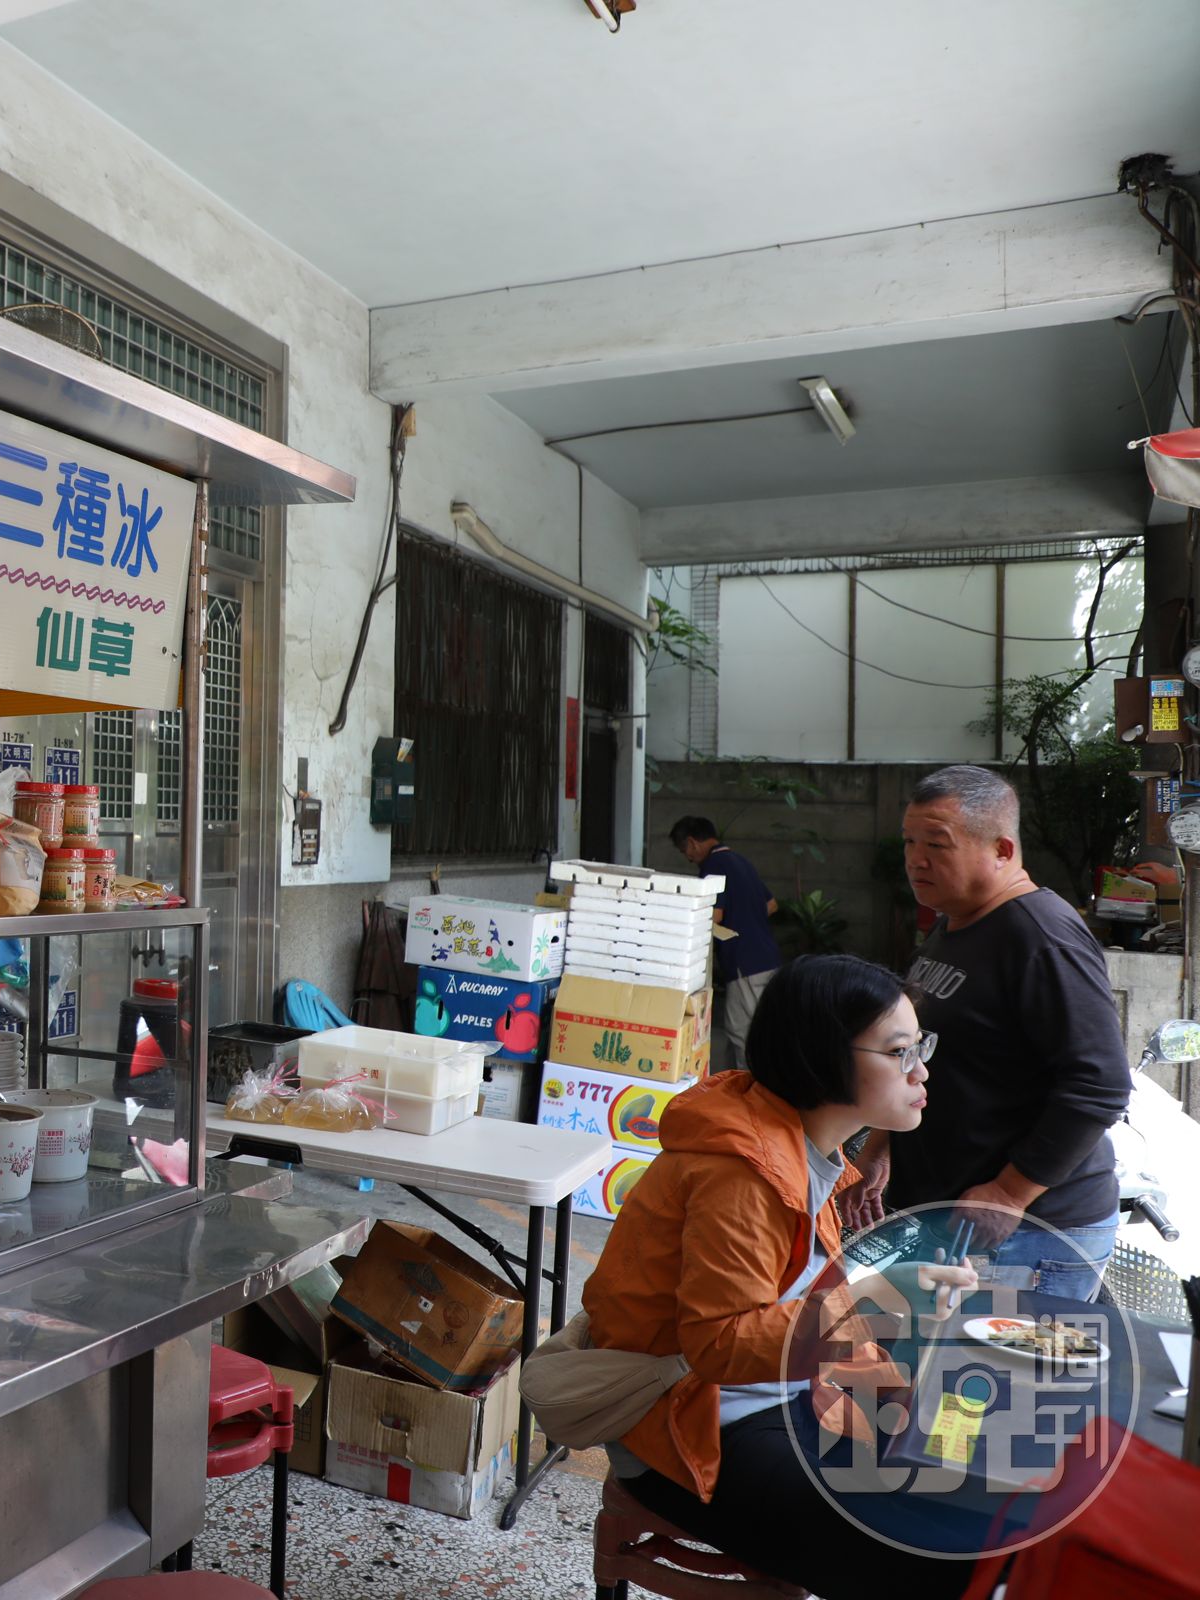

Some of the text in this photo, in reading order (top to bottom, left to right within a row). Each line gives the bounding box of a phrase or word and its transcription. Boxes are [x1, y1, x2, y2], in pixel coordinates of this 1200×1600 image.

[36, 606, 135, 678] 仙草
[458, 981, 504, 997] RUCARAY
[453, 1014, 493, 1028] APPLES
[578, 1081, 614, 1104] 777
